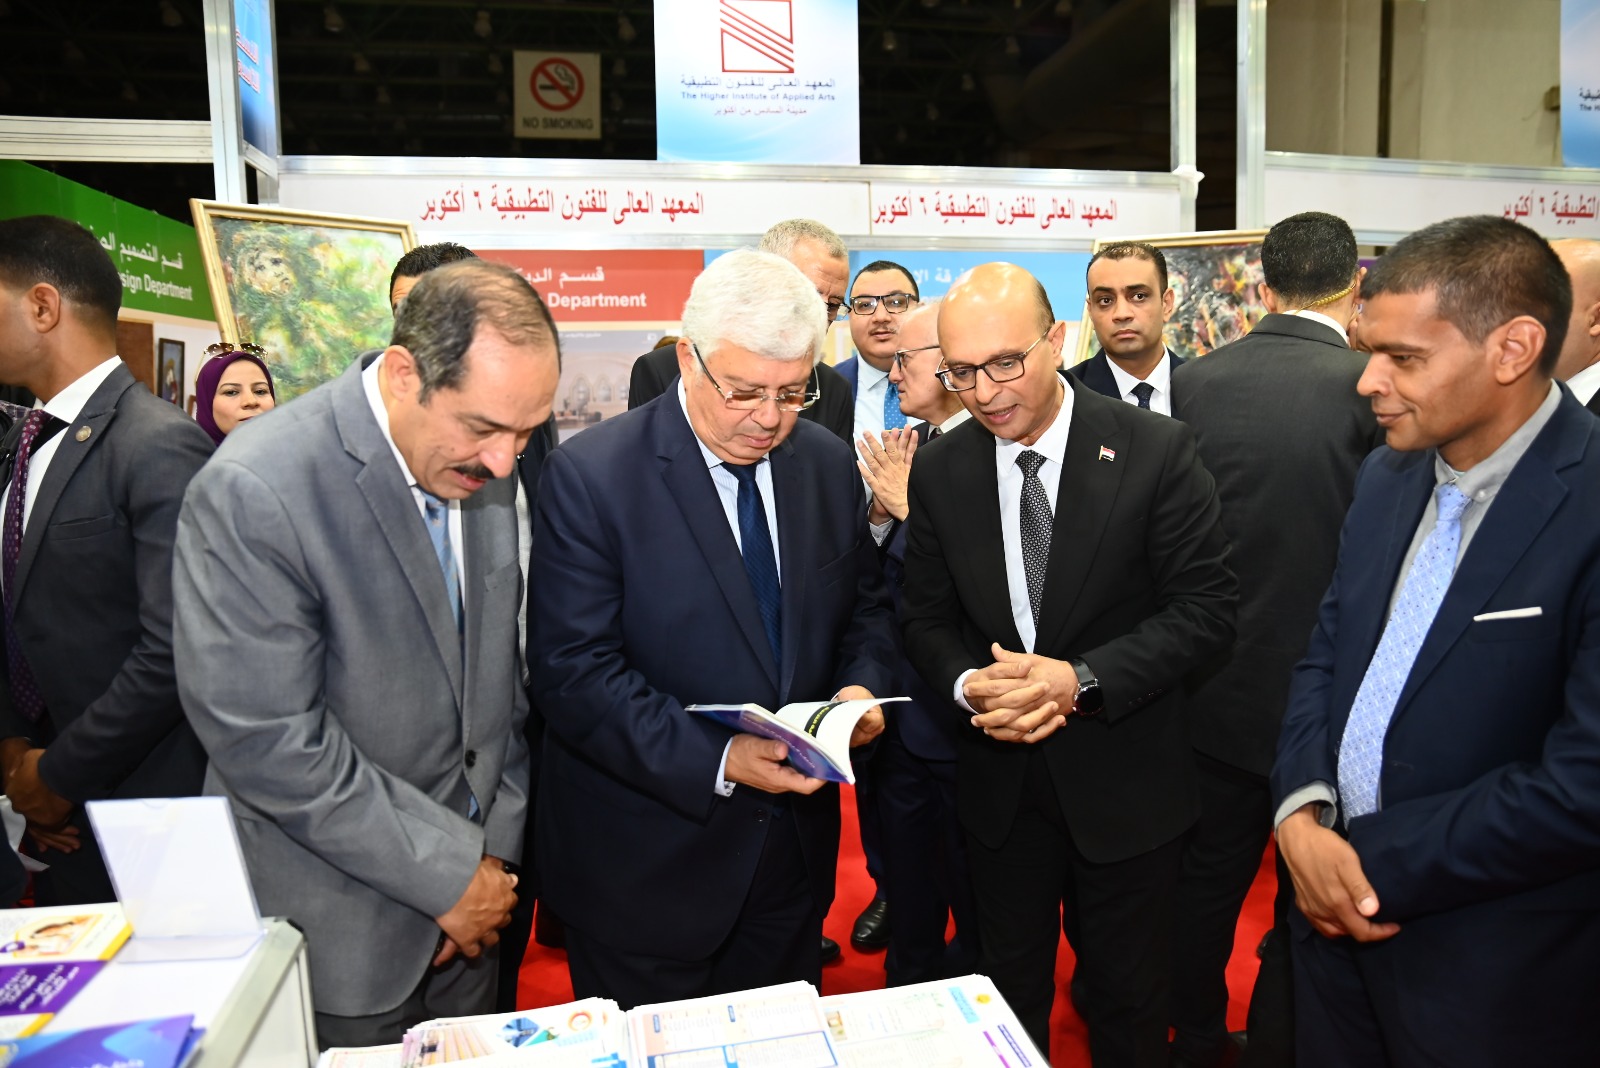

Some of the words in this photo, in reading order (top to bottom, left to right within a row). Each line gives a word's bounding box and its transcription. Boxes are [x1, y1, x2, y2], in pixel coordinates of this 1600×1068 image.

[681, 92, 697, 100] The
[700, 92, 729, 101] Higher
[732, 92, 767, 100] Institute
[771, 92, 779, 100] of
[783, 93, 815, 101] Applied
[818, 93, 836, 101] Arts
[726, 77, 764, 89] للفنون
[805, 77, 835, 91] المعهد
[522, 117, 540, 129] NO
[542, 117, 594, 130] SMOKING
[420, 182, 465, 221] أكتوبر
[473, 189, 483, 211] ٦
[490, 183, 555, 221] التطبيقية
[561, 188, 608, 220] للفنون
[613, 189, 654, 225] العالى
[661, 190, 704, 222] المعهد
[872, 188, 913, 224] أكتوبر
[918, 196, 928, 216] ٦
[995, 195, 1036, 225] للفنون
[1040, 197, 1075, 230] العالى
[1081, 198, 1118, 228] المعهد
[1551, 190, 1600, 225] التطبيقية
[120, 242, 159, 264] التصميم
[161, 251, 184, 275] قسم
[118, 269, 143, 295] sign
[144, 273, 194, 301] Department
[558, 266, 605, 289] قسم
[547, 291, 647, 311] Department
